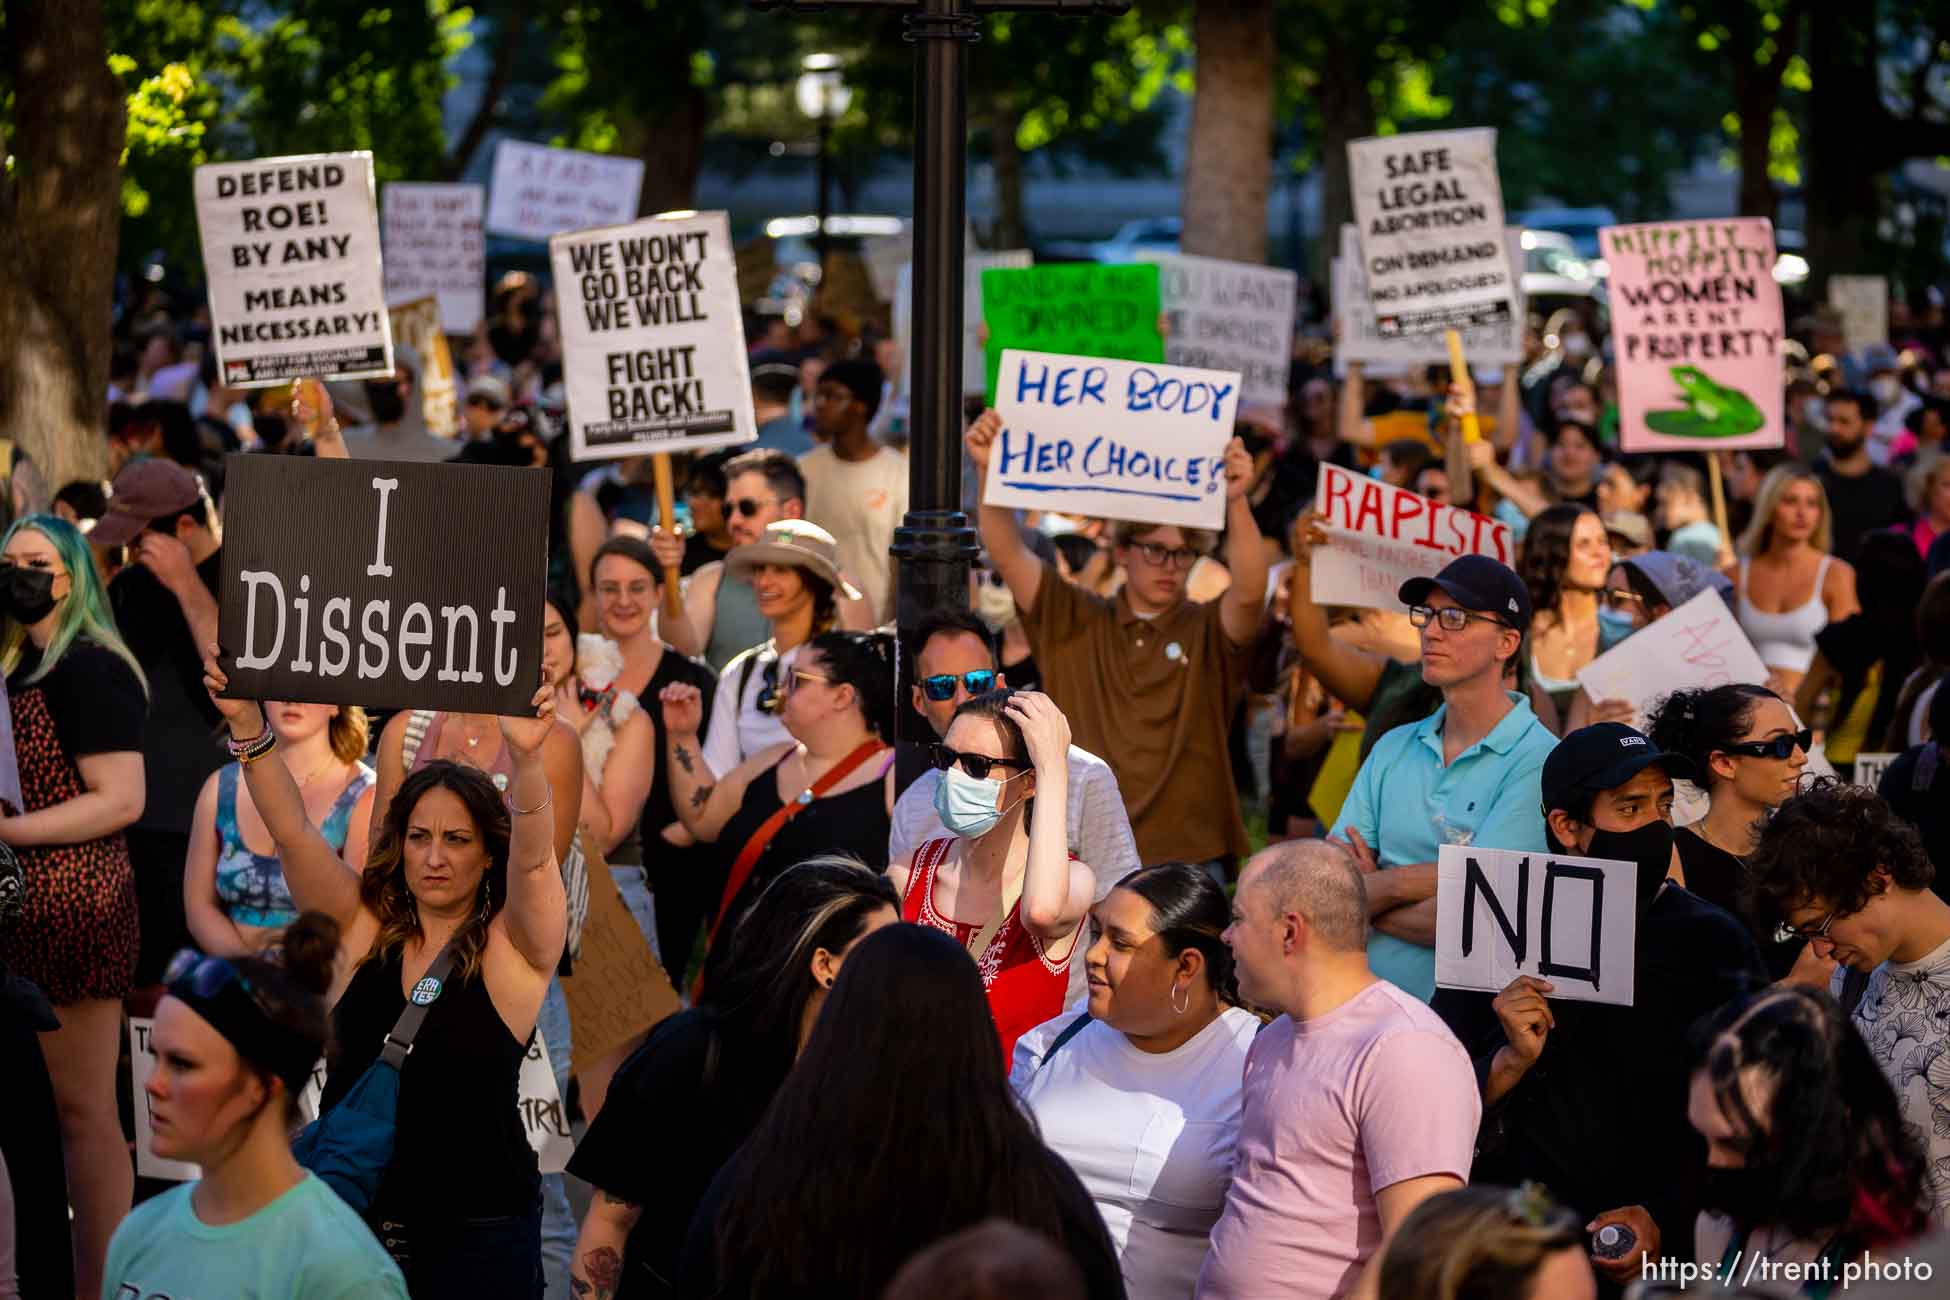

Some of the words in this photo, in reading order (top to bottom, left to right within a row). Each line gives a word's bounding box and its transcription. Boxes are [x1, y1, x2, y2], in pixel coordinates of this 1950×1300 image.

[216, 164, 345, 199] DEFEND
[1384, 148, 1451, 180] SAFE
[1378, 178, 1468, 211] LEGAL
[241, 201, 329, 232] ROE!
[1370, 204, 1487, 236] ABORTION
[231, 242, 272, 268] BY
[281, 233, 352, 263] ANY
[568, 242, 614, 273] WE
[618, 231, 710, 267] WON'T
[1370, 256, 1404, 275] ON
[1406, 241, 1498, 270] DEMAND
[1646, 247, 1769, 276] HOPPITY
[243, 281, 348, 313] MEANS
[580, 271, 618, 301] GO
[625, 263, 705, 298] BACK
[1620, 275, 1758, 308] WOMEN
[219, 311, 381, 346] NECESSARY!
[584, 301, 632, 333] WE
[635, 294, 709, 326] WILL
[1625, 328, 1780, 360] PROPERTY
[606, 344, 697, 385] FIGHT
[607, 379, 705, 420] BACK!
[1016, 357, 1109, 407] HER
[1126, 367, 1233, 421] BODY
[998, 427, 1074, 475] HER
[366, 476, 399, 578] I
[1325, 467, 1510, 564] RAPISTS
[235, 569, 518, 687] Dissent
[1621, 737, 1646, 746] VANS
[1462, 855, 1605, 992] NO
[413, 990, 435, 1001] YES
[416, 977, 439, 991] ERA
